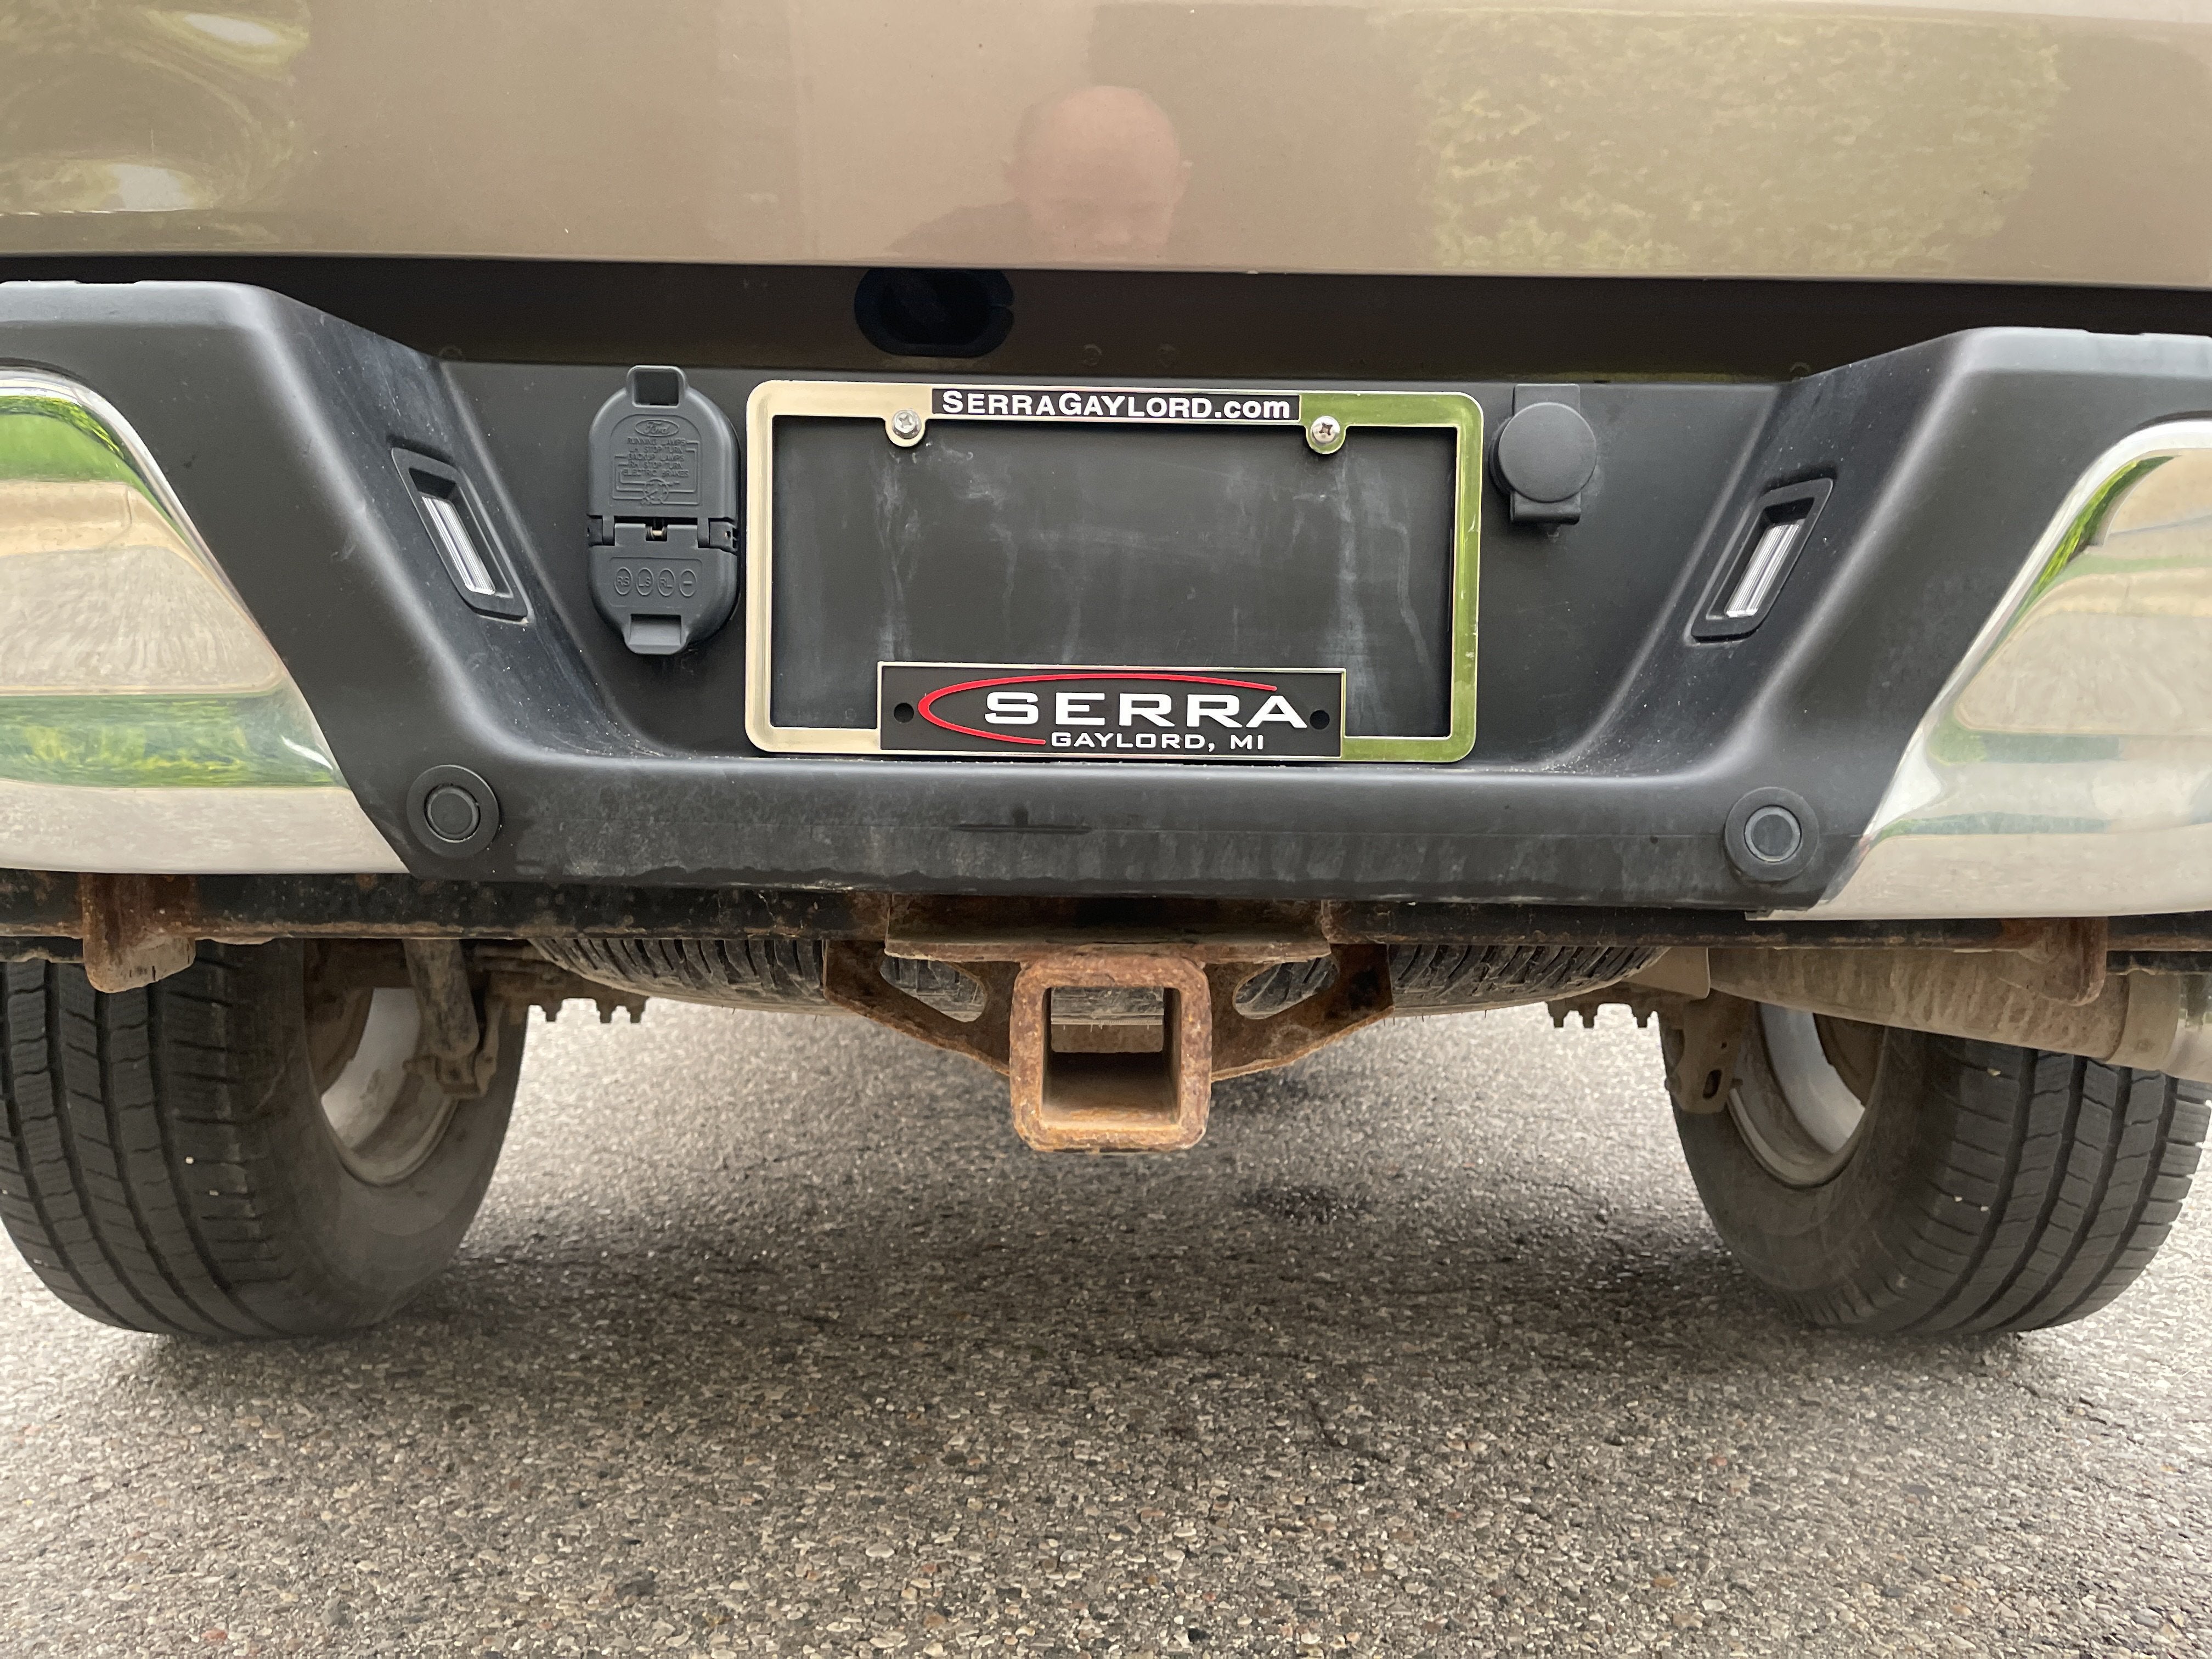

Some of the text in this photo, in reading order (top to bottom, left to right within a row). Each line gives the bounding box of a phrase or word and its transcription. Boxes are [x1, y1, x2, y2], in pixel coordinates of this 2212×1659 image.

[942, 390, 1290, 419] SERRAGAYLORD.com
[644, 421, 671, 435] Ford
[622, 468, 690, 477] ELECTRIC BRAKES
[617, 576, 630, 586] RS
[637, 577, 651, 587] LS
[660, 577, 673, 589] RL
[984, 691, 1307, 729] SERRA
[1051, 732, 1263, 752] GAYLORD, MI
